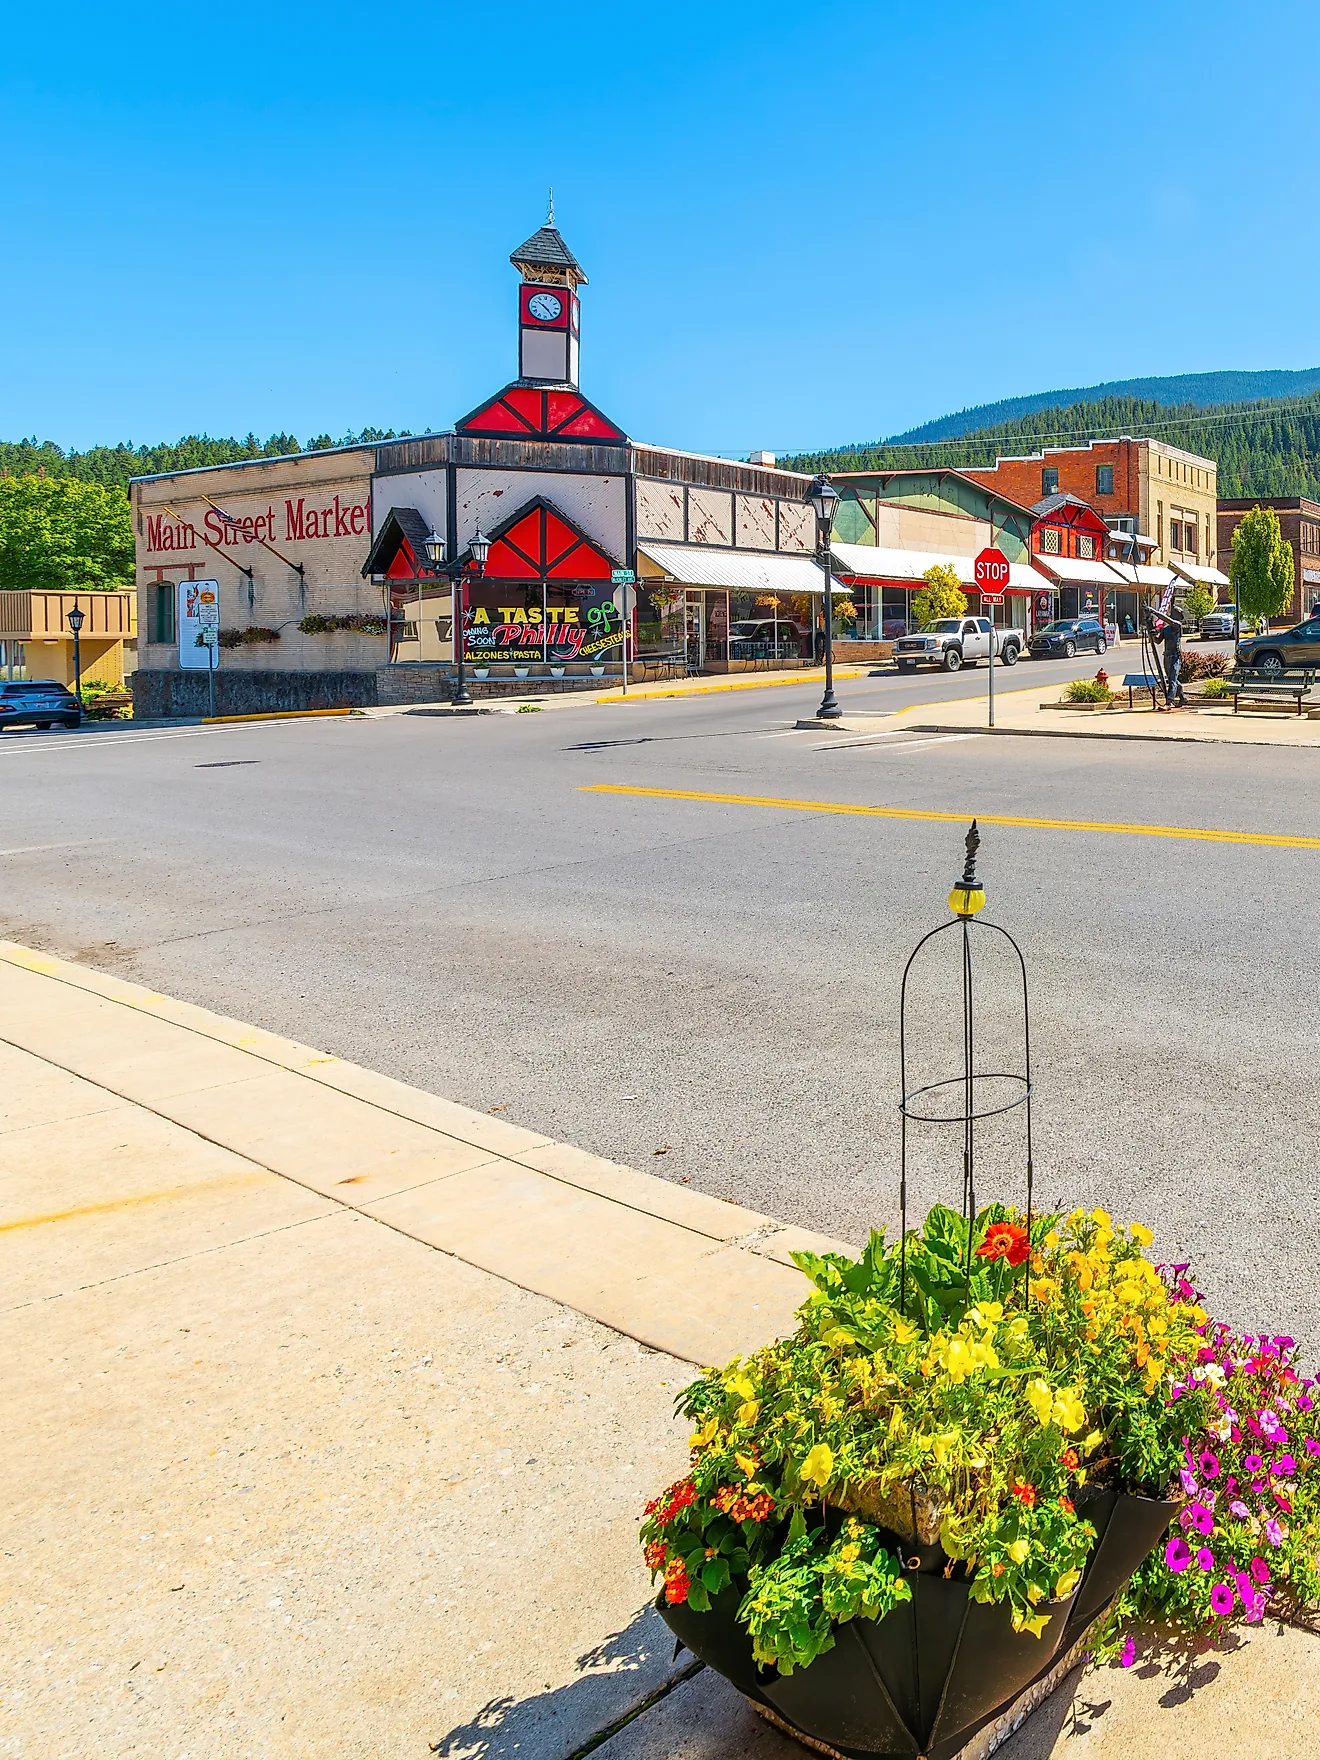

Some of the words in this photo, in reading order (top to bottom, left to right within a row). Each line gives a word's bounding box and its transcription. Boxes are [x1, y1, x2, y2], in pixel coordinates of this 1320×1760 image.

[147, 513, 197, 552] Main
[976, 561, 1008, 580] STOP
[473, 608, 490, 624] A
[498, 607, 580, 624] TASTE
[463, 627, 489, 636] OMING
[467, 635, 496, 646] SOON
[492, 624, 587, 660] Philly
[579, 630, 631, 657] CHEESESTEAS
[464, 651, 509, 660] ALZONES
[513, 650, 541, 659] PASTA
